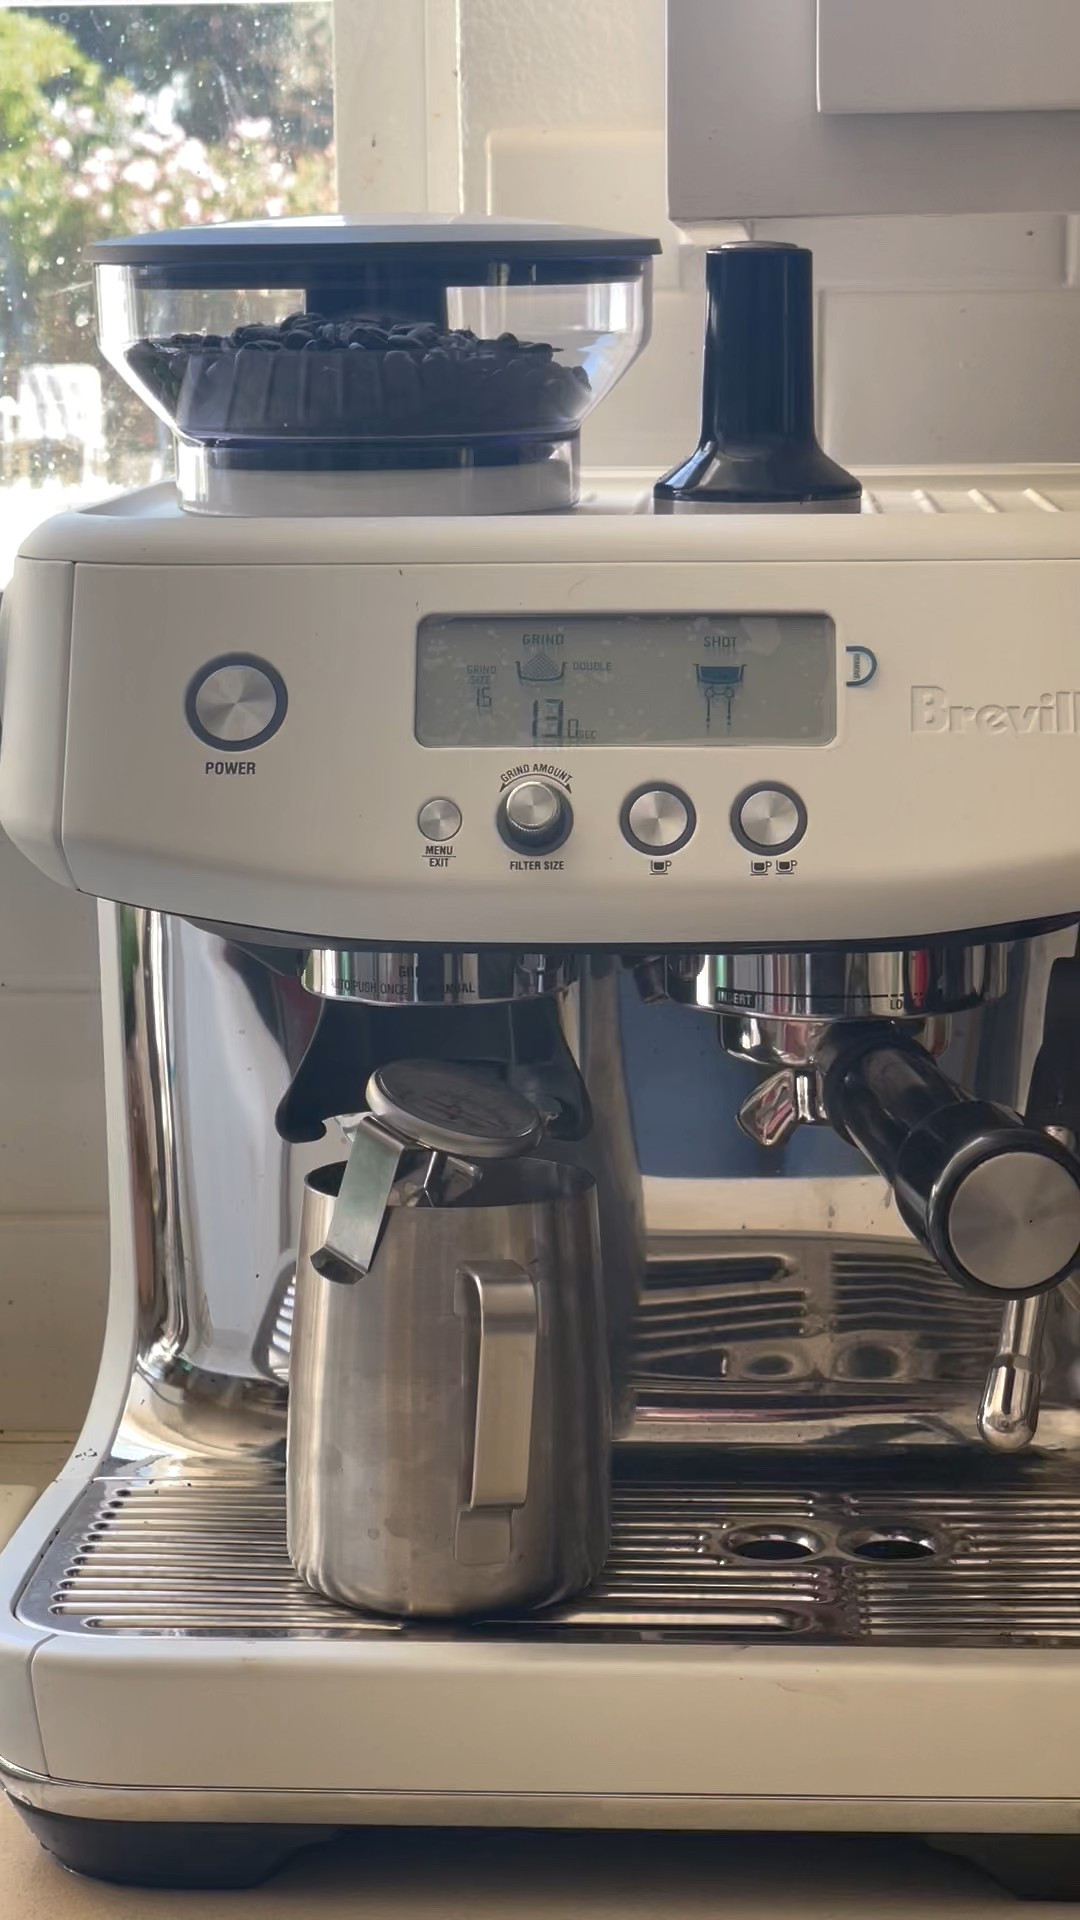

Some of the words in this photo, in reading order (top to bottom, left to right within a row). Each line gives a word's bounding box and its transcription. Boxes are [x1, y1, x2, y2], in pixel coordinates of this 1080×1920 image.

[522, 633, 565, 646] GRIND
[703, 635, 737, 648] SHOT
[466, 664, 497, 675] GRIND
[573, 661, 612, 671] DOUBLE
[471, 675, 491, 685] SIZE
[205, 761, 256, 775] POWER
[500, 764, 530, 783] GRIND
[533, 763, 573, 783] AMOUNT
[425, 845, 453, 856] MENU
[429, 857, 449, 868] EXIT
[509, 860, 541, 871] FILTER
[543, 860, 565, 871] SIZE
[380, 983, 409, 995] ONCE
[717, 990, 753, 1006] INERT
